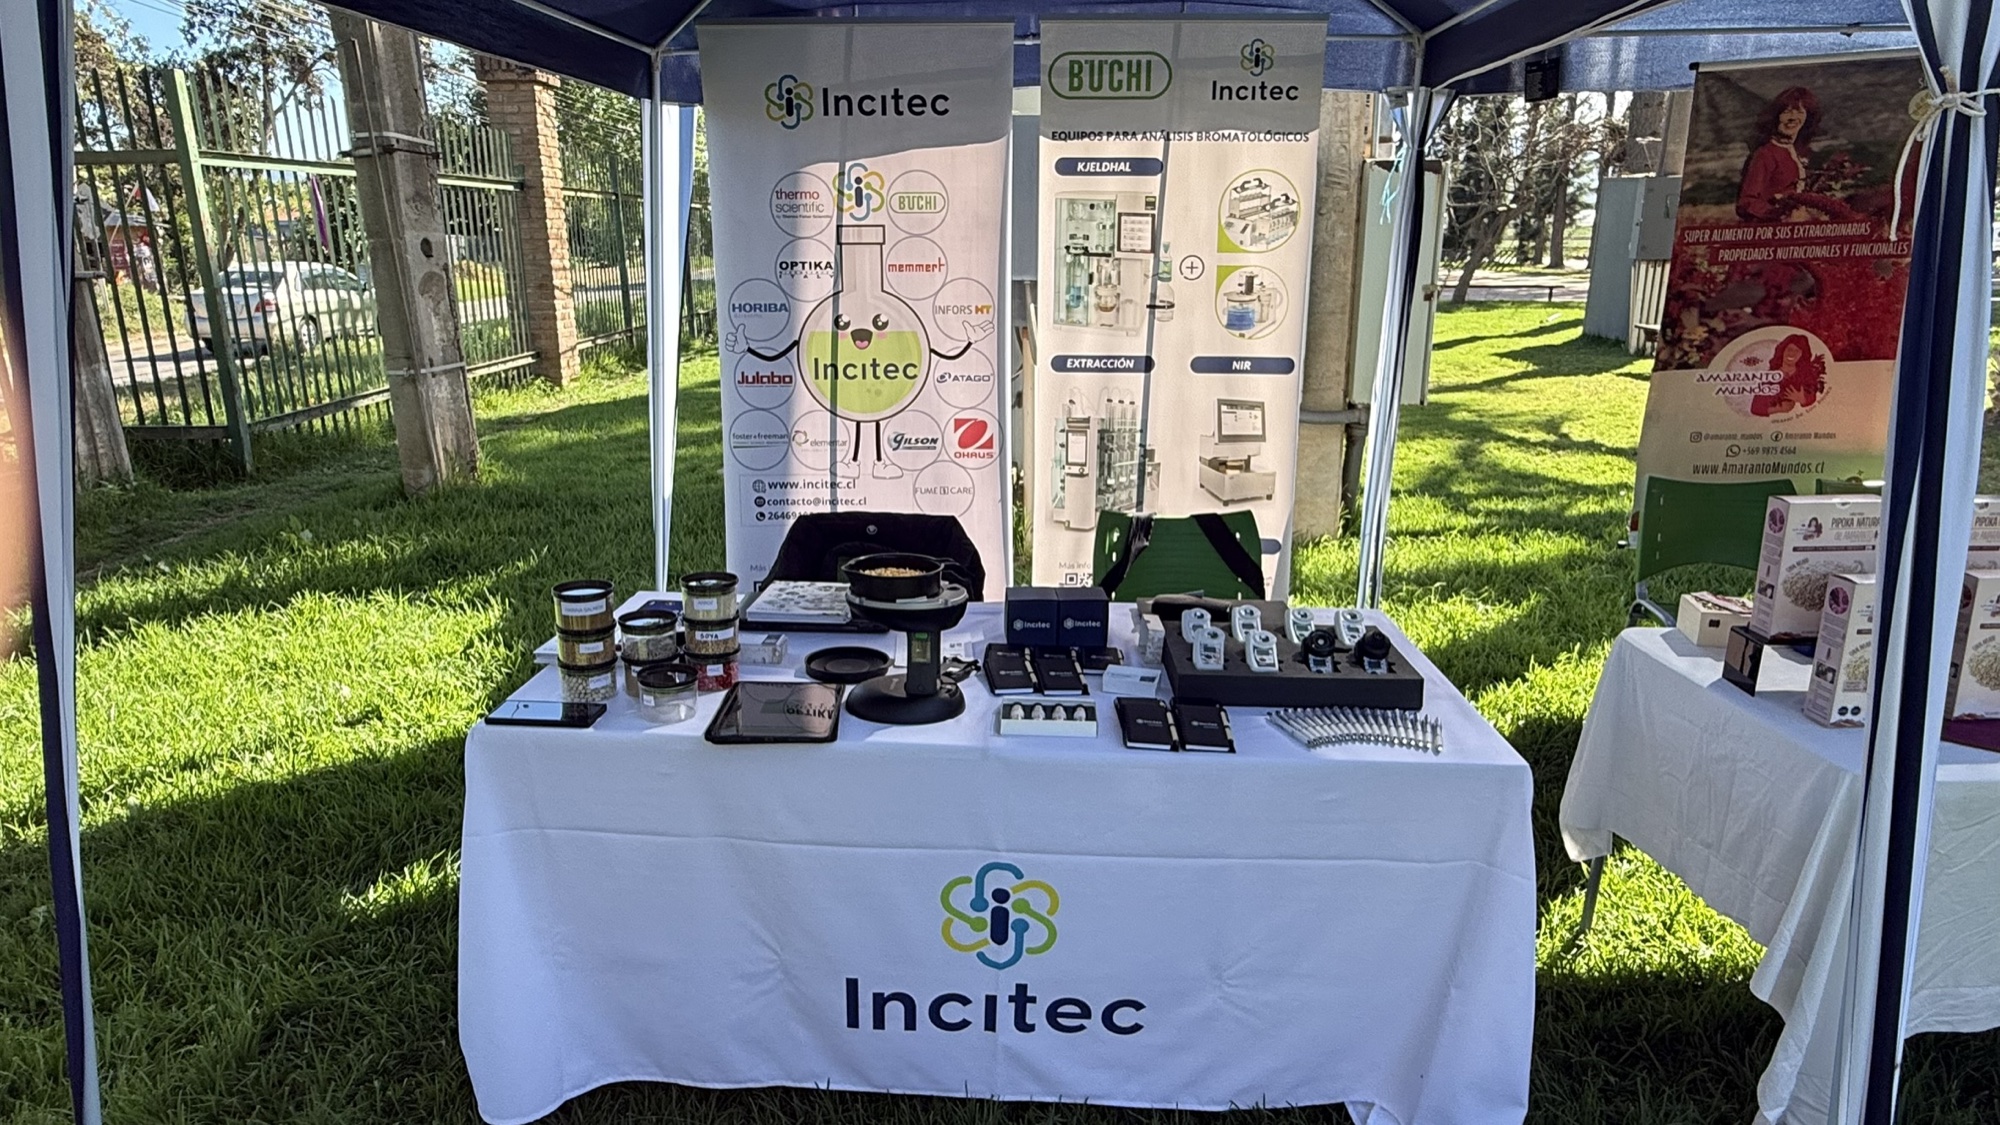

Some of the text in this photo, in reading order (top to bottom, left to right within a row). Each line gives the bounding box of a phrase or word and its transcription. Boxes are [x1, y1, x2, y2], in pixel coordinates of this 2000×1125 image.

[1212, 80, 1299, 101] Incitec
[822, 87, 950, 117] Incitec
[1051, 129, 1309, 143] EQUIPOS PARA ANÁLISIS BROMATOLÓGICOS
[1077, 161, 1132, 172] KJELDHAL
[775, 188, 820, 200] thermo
[775, 201, 825, 213] scientific
[1684, 222, 1871, 244] SUPER ALIMENTO POR SUS EXTRAORDINARIAS
[1718, 241, 1909, 262] PROPIEDADES NUTRICIONALES Y FUNCIONALES
[779, 261, 834, 271] OPTIKA
[888, 257, 946, 273] memmert
[732, 302, 789, 313] HORIBA
[935, 305, 973, 315] INFORS
[814, 357, 919, 381] Incitec
[1066, 357, 1134, 370] EXTRACCIÓN
[1232, 360, 1252, 371] NIR
[737, 371, 793, 385] Julabo
[1696, 372, 1782, 383] AMARANTO
[1692, 460, 1825, 475] www.AmarantoMundos.cl
[768, 479, 856, 490] www.incitec.cl
[915, 486, 973, 495] FUME CARE
[767, 497, 867, 506] contacto@incitec.cl
[1831, 516, 1855, 528] PIPOKA
[845, 977, 1147, 1035] Incitec
